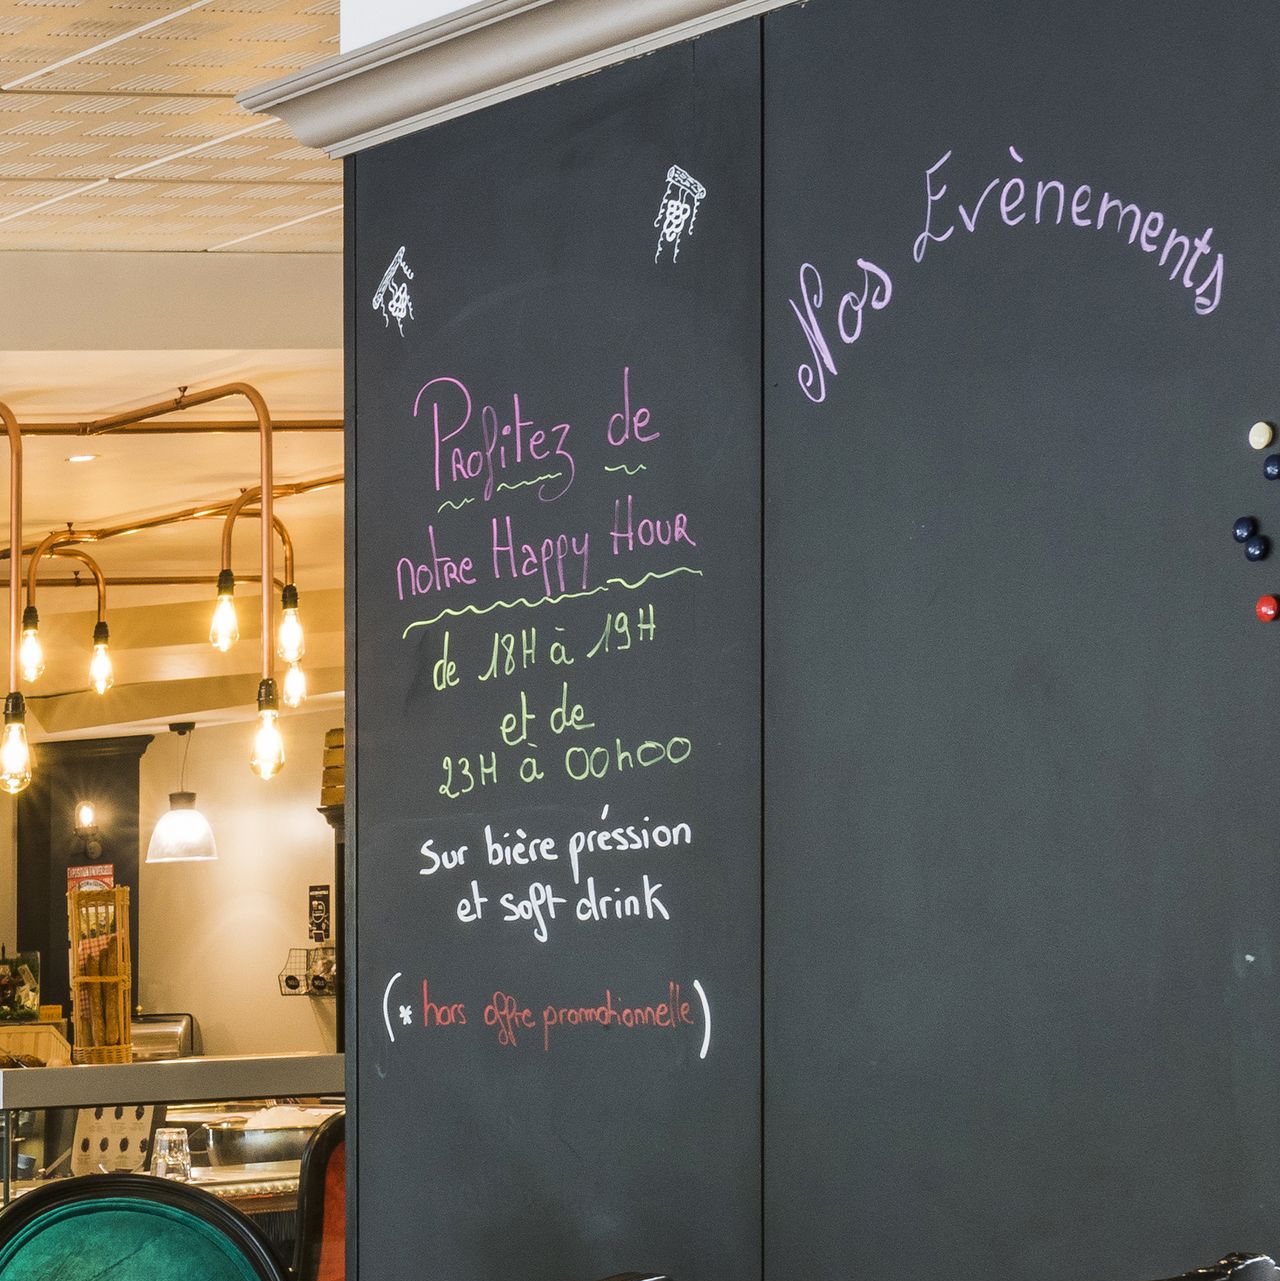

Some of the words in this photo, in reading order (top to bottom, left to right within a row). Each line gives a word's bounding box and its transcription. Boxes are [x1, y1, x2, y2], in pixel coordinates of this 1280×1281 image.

[789, 257, 893, 403] Nos
[605, 366, 661, 447] de
[491, 514, 589, 598] Happy
[431, 630, 460, 692] de
[477, 627, 538, 682] 18H
[586, 603, 657, 660] 19H
[499, 690, 536, 747] et
[549, 680, 596, 735] de
[438, 749, 498, 800] 23H
[418, 839, 469, 876] Sur
[484, 823, 559, 868] bière
[456, 879, 488, 923] et
[502, 881, 568, 943] soft
[575, 874, 670, 922] drink
